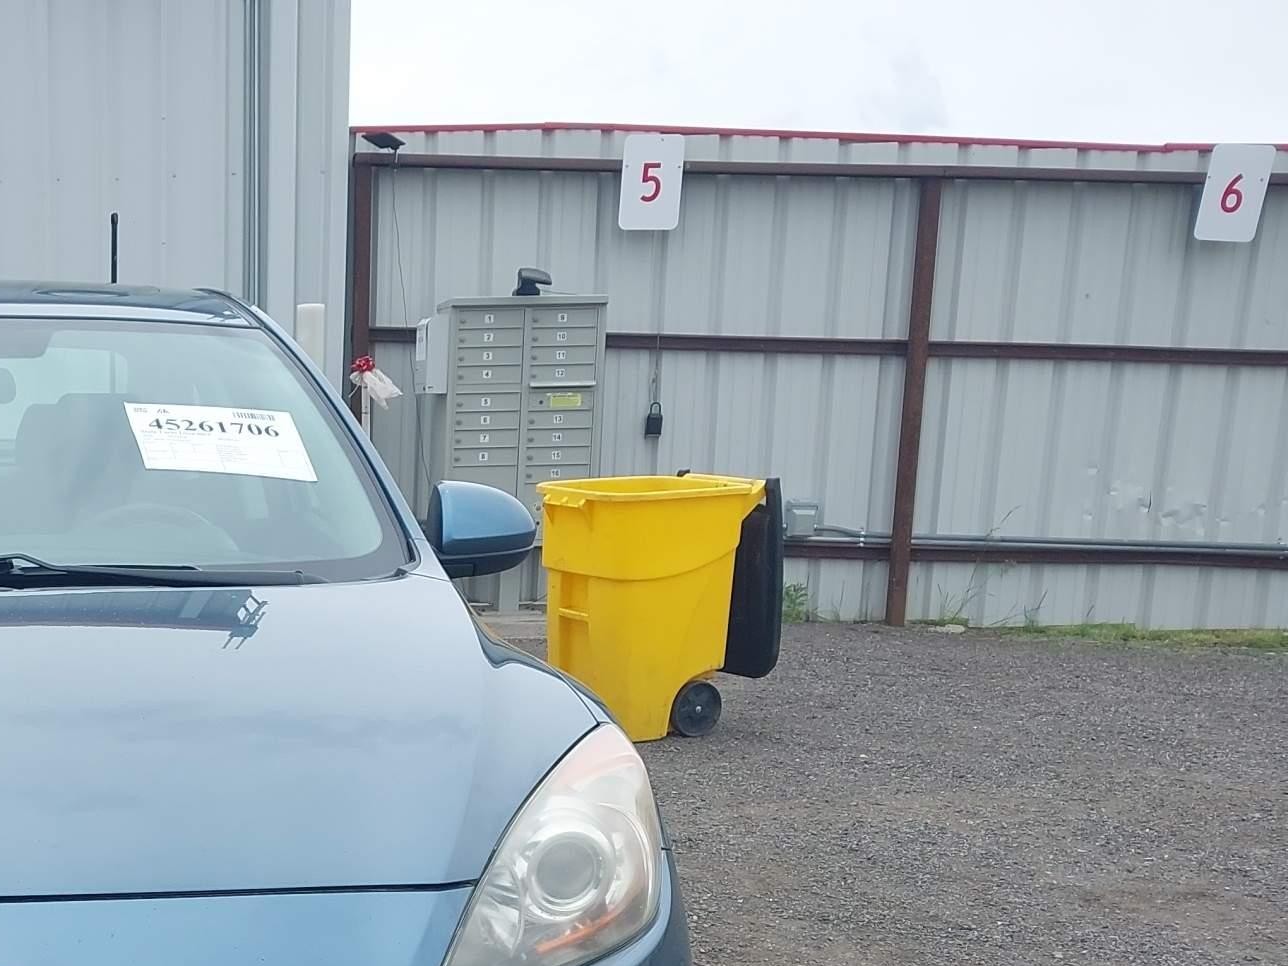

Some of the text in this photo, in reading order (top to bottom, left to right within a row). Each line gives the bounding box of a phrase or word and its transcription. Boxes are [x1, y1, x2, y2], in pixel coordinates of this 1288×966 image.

[640, 162, 662, 202] 5
[1220, 173, 1243, 213] 6
[148, 417, 280, 438] 45261706
